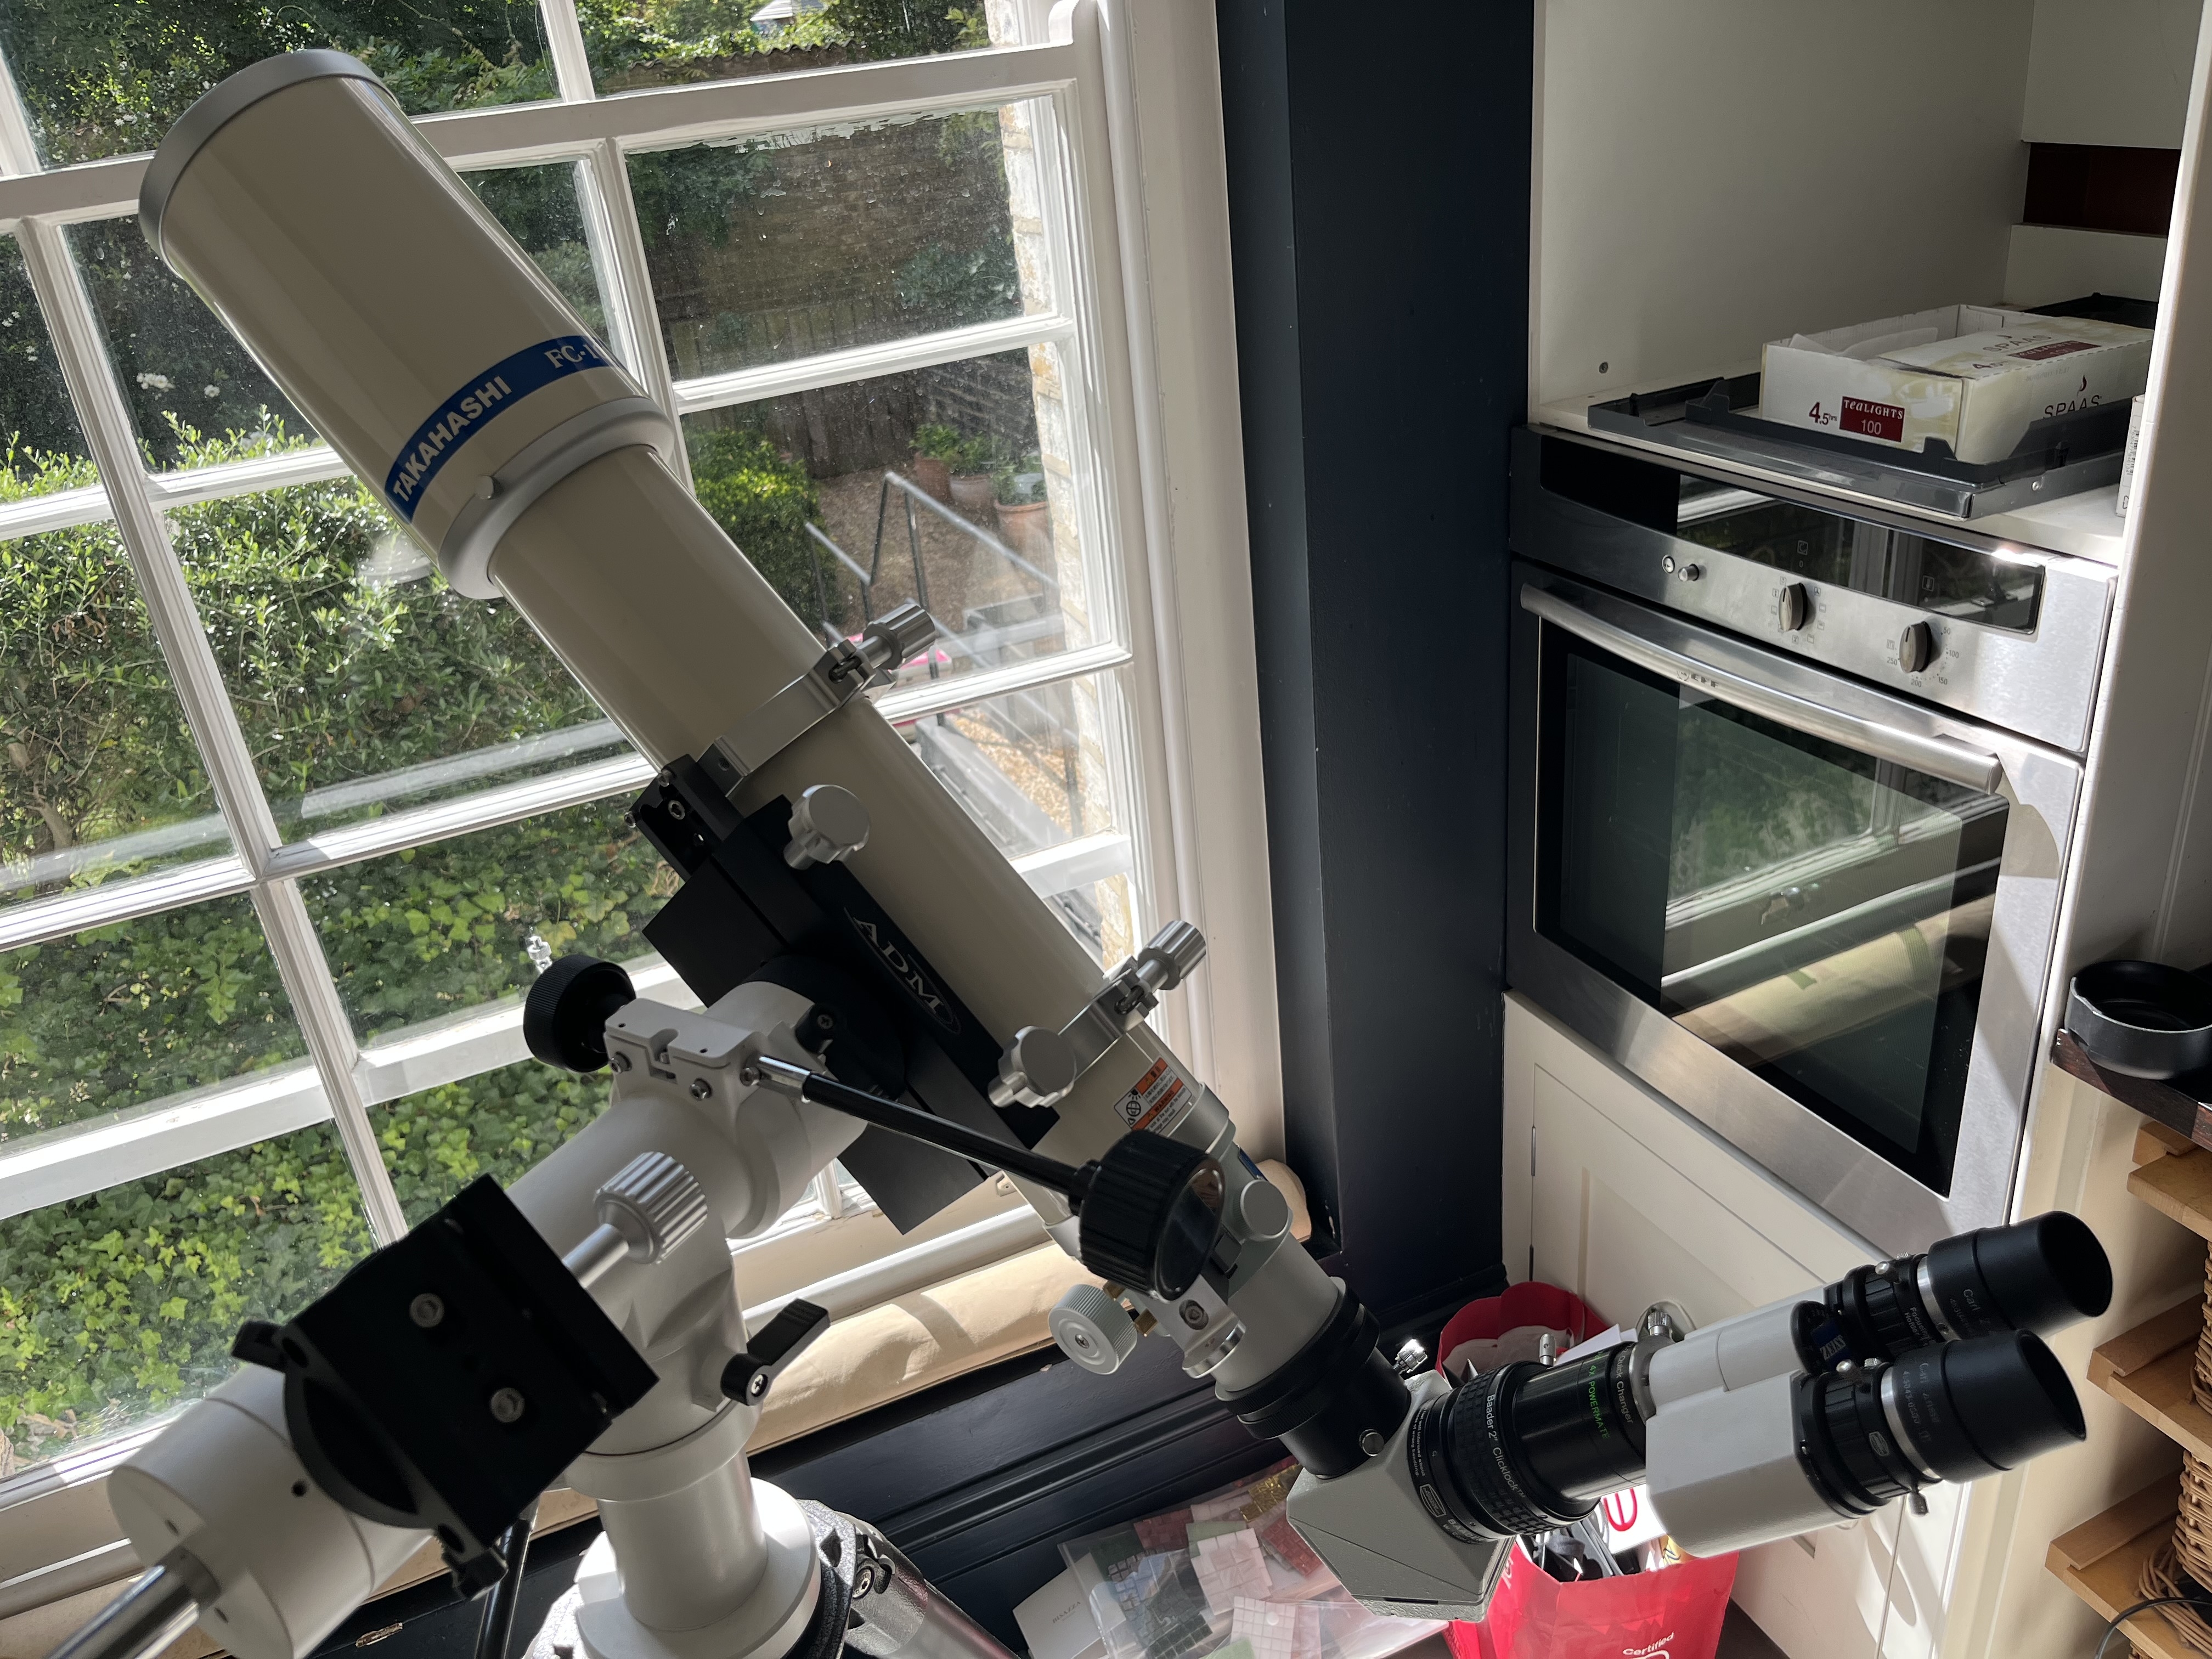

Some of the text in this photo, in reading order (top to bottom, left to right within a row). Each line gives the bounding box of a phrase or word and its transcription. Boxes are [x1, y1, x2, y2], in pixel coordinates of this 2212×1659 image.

[2045, 394, 2100, 417] SPAAS
[392, 343, 605, 503] TAKAHASHI FC-1
[1861, 419, 1882, 435] 100
[1943, 627, 1951, 635] 50
[1887, 656, 1898, 666] 250
[1949, 650, 1959, 659] 100
[1911, 678, 1922, 687] 200
[1938, 676, 1948, 686] 150
[853, 917, 945, 1014] ADM
[1963, 1289, 1981, 1311] Carl
[1616, 1356, 1626, 1379] Quick
[1486, 1394, 1496, 1429] Baader
[1588, 1380, 1611, 1439] POWERMATE
[1616, 1380, 1634, 1424] Changer
[1622, 1632, 1674, 1656] Certified
